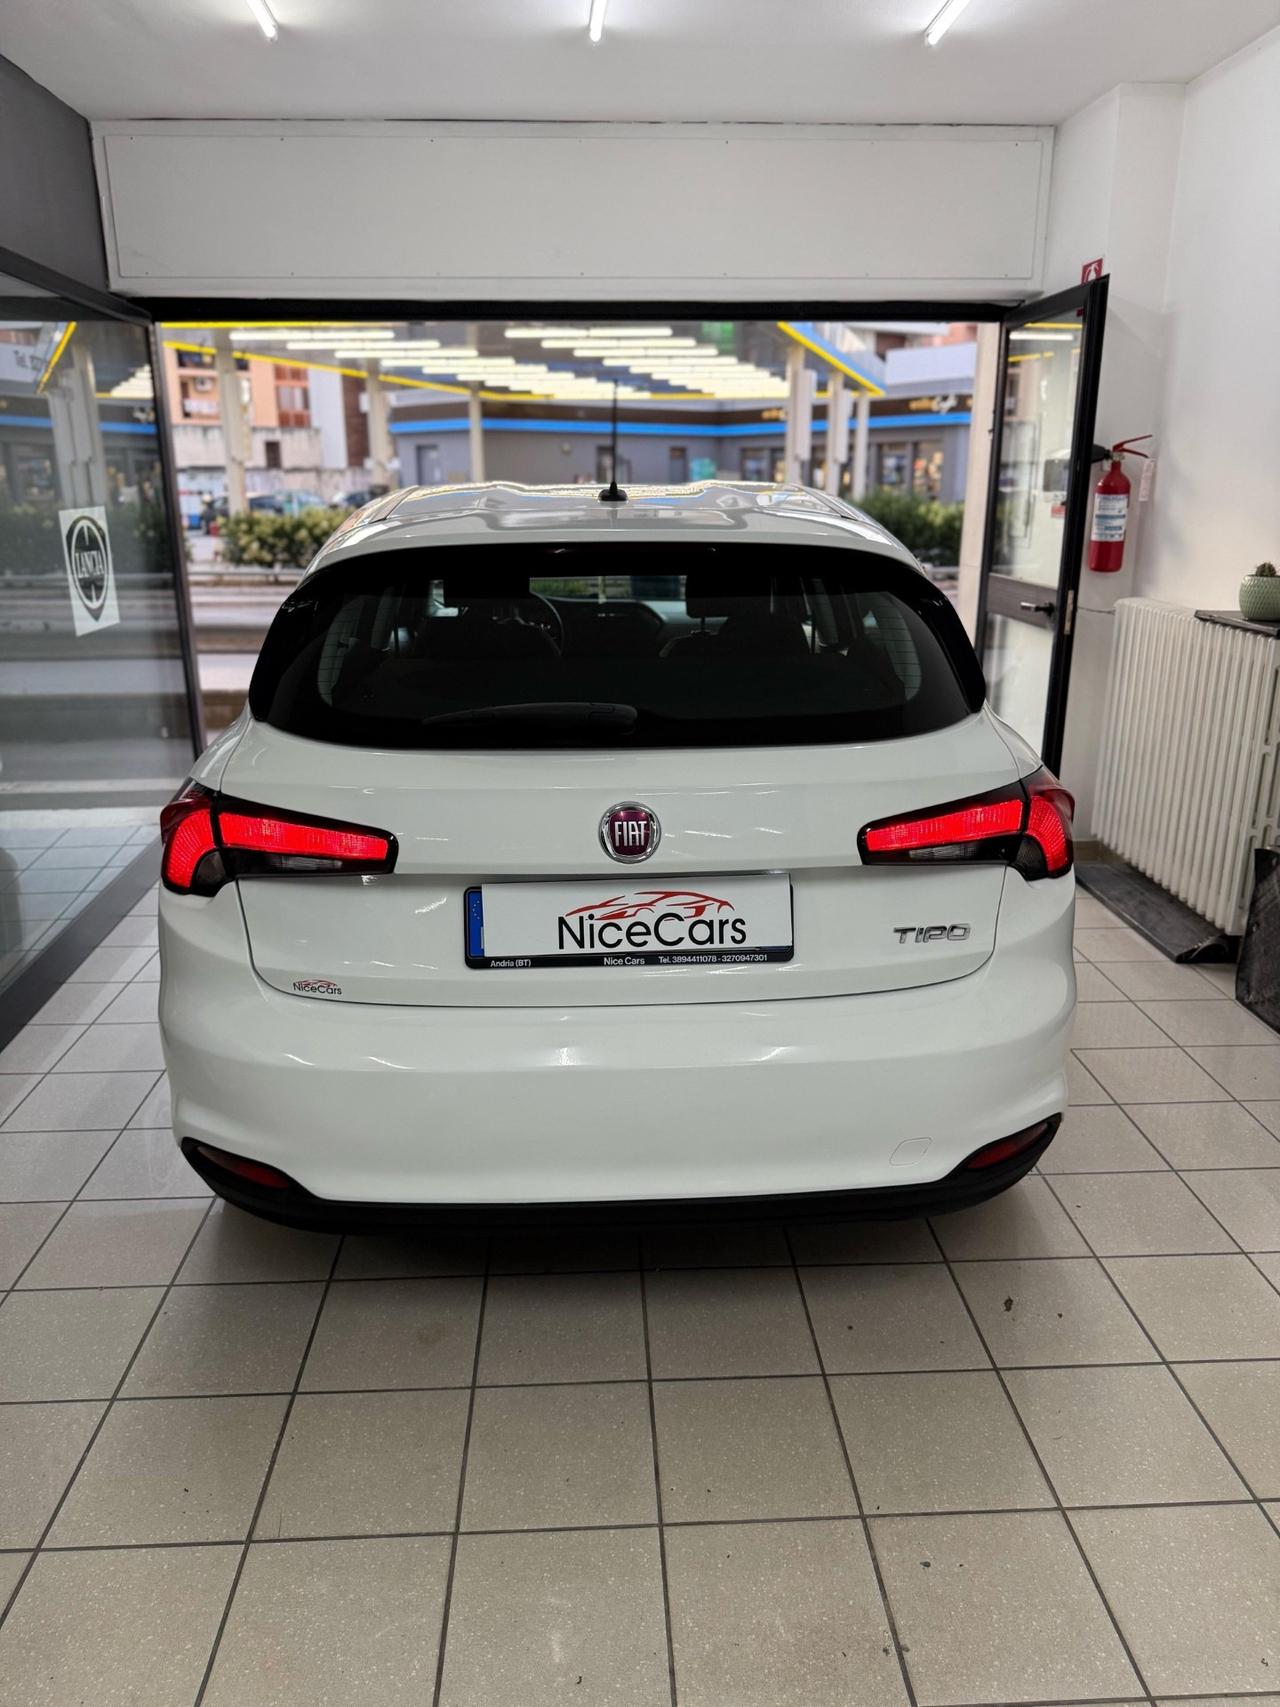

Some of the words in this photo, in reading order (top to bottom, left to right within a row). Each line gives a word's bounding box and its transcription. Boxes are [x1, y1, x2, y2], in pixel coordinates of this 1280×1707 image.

[74, 550, 105, 579] LANCIA
[614, 820, 648, 847] FIAT
[557, 912, 746, 949] NiceCars
[893, 923, 971, 944] TIPO
[490, 959, 514, 968] Andria
[515, 958, 531, 967] (BT)
[603, 957, 624, 966] Nice
[624, 956, 646, 965] Cars
[671, 955, 717, 964] 3894411078
[721, 953, 768, 962] 3270947301
[292, 981, 343, 995] NiceCars
